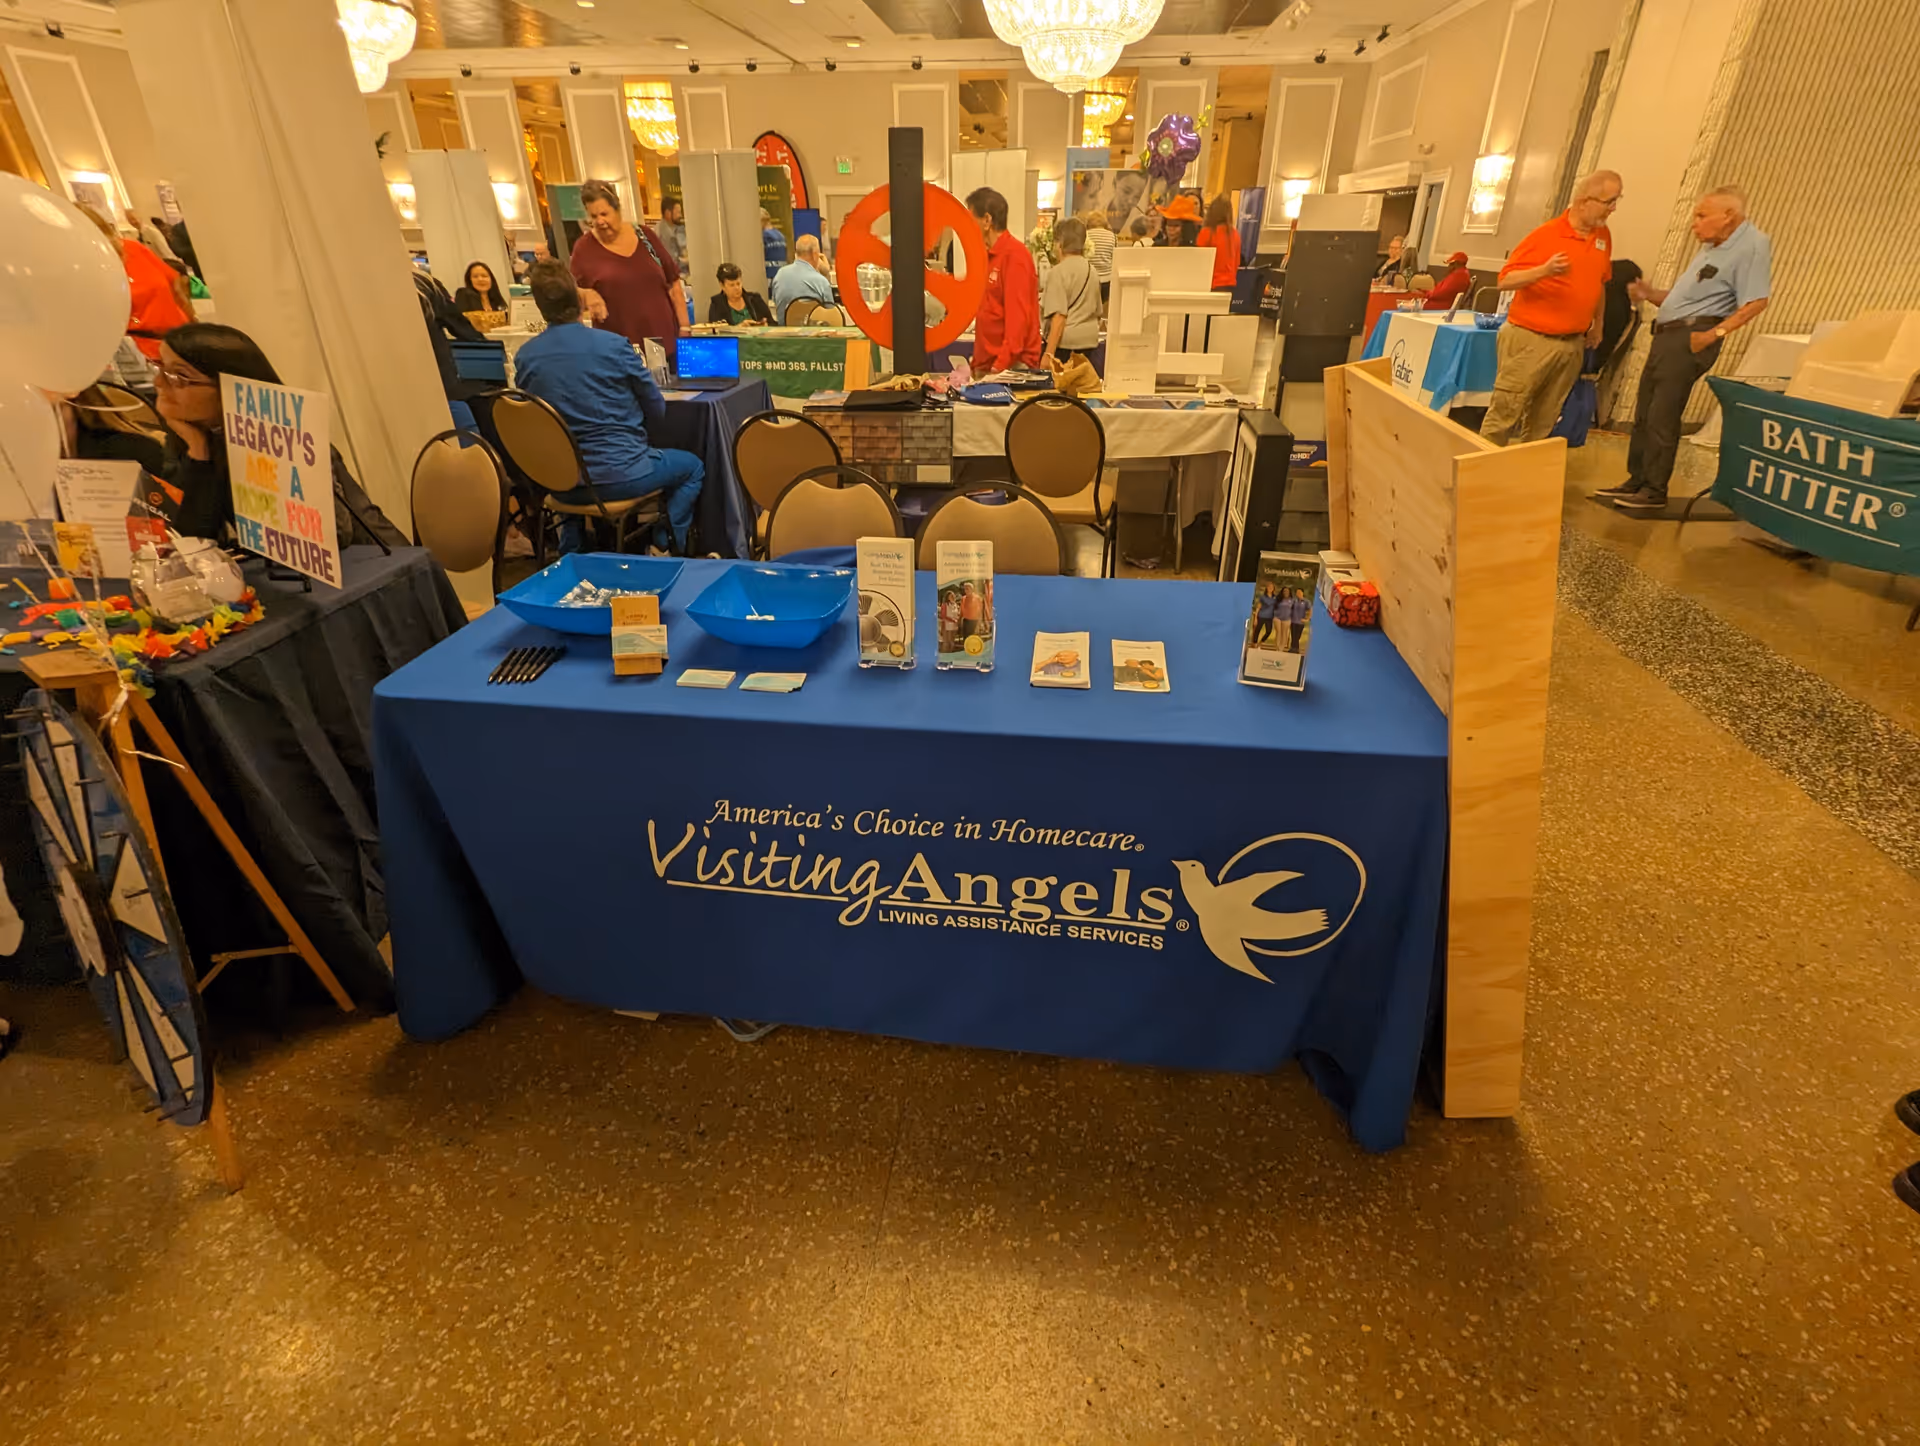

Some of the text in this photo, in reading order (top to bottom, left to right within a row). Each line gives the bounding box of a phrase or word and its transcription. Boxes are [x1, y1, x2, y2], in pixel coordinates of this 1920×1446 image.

[740, 361, 762, 370] TOPS
[765, 361, 786, 371] #MD
[810, 361, 846, 372] FALLST
[234, 382, 304, 430] FAMILY
[226, 412, 316, 467] LEGACY'S
[1762, 419, 1875, 478] BATH
[245, 451, 305, 501] ARE A
[285, 500, 325, 544] FOR
[235, 513, 336, 584] THE FUTURE
[705, 799, 845, 831] America's
[853, 808, 945, 837] Choice
[953, 816, 982, 840] in
[647, 819, 893, 927] Visiting
[878, 909, 1164, 951] LIVING ASSISTANCE SERVICES
